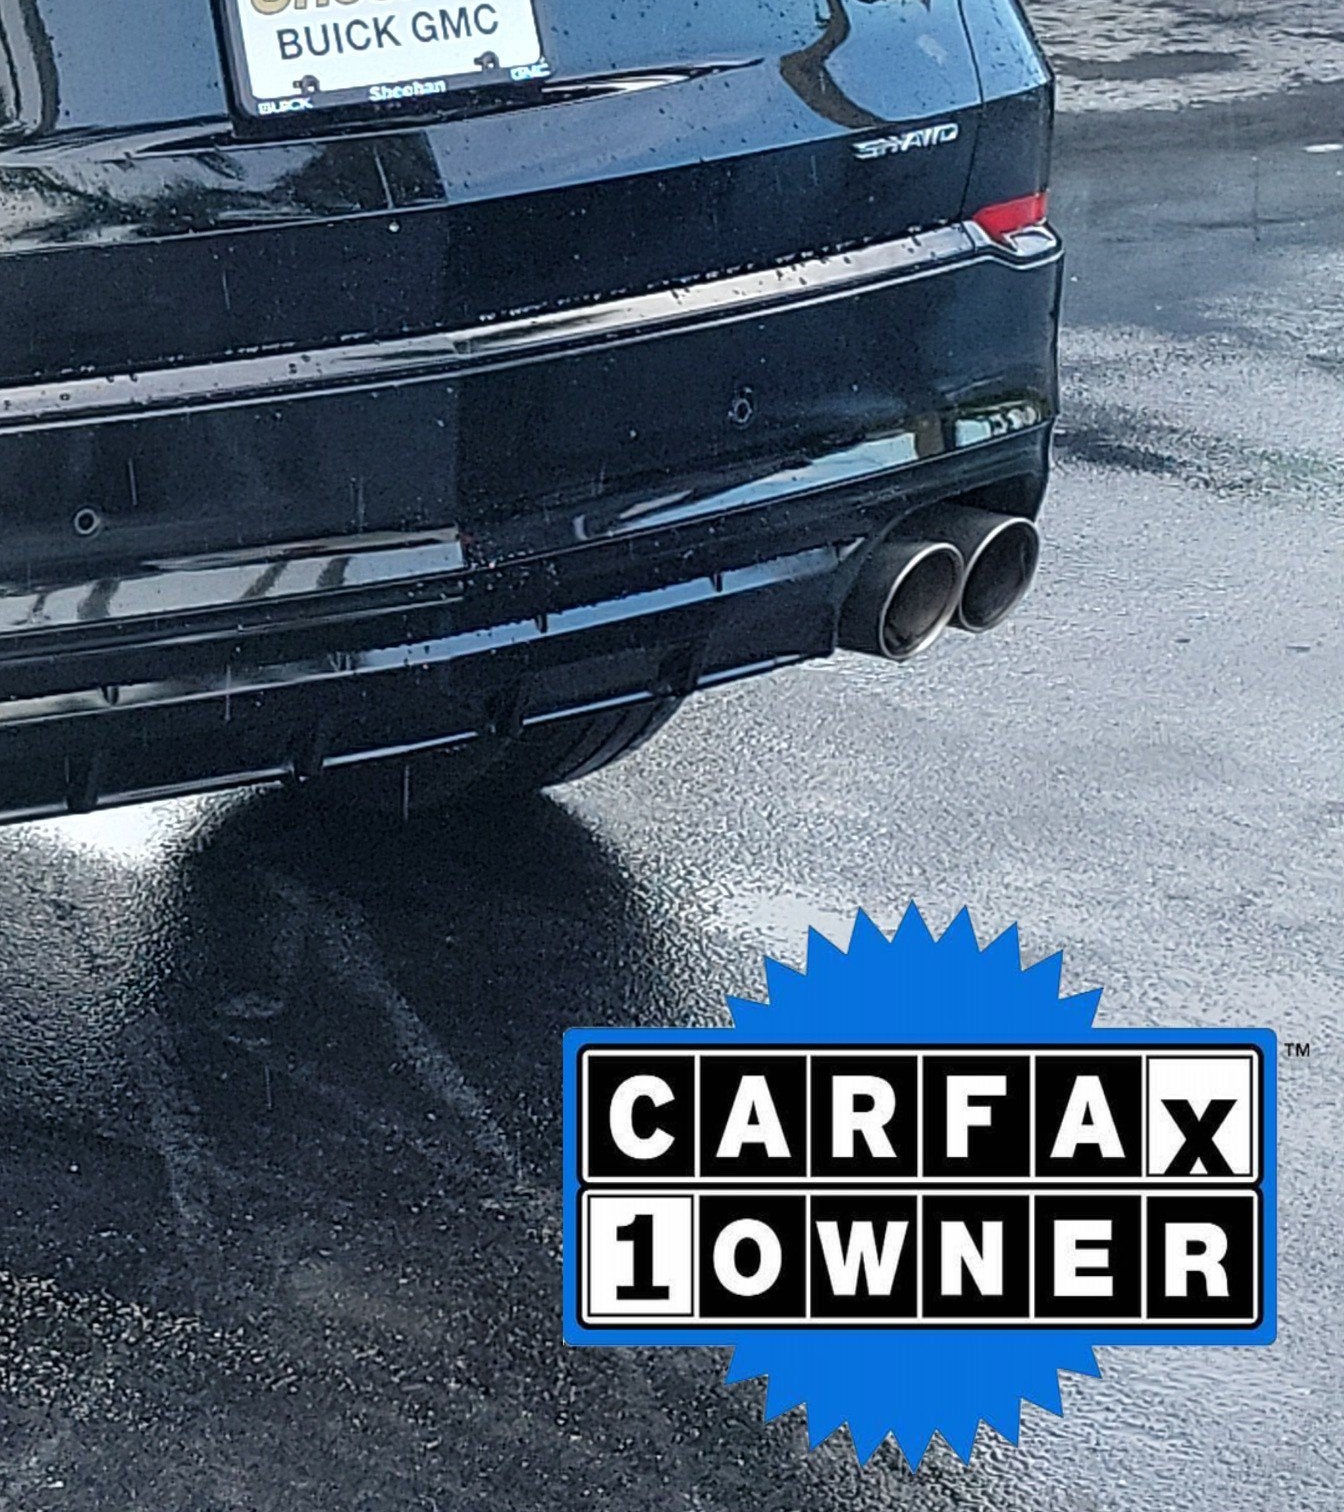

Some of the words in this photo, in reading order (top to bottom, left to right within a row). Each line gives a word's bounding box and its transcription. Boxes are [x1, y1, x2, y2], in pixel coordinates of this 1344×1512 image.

[276, 14, 402, 60] BUICK
[411, 3, 500, 40] GMC
[510, 63, 551, 81] GMC
[368, 79, 447, 102] Sheehan
[257, 96, 313, 115] BUICK
